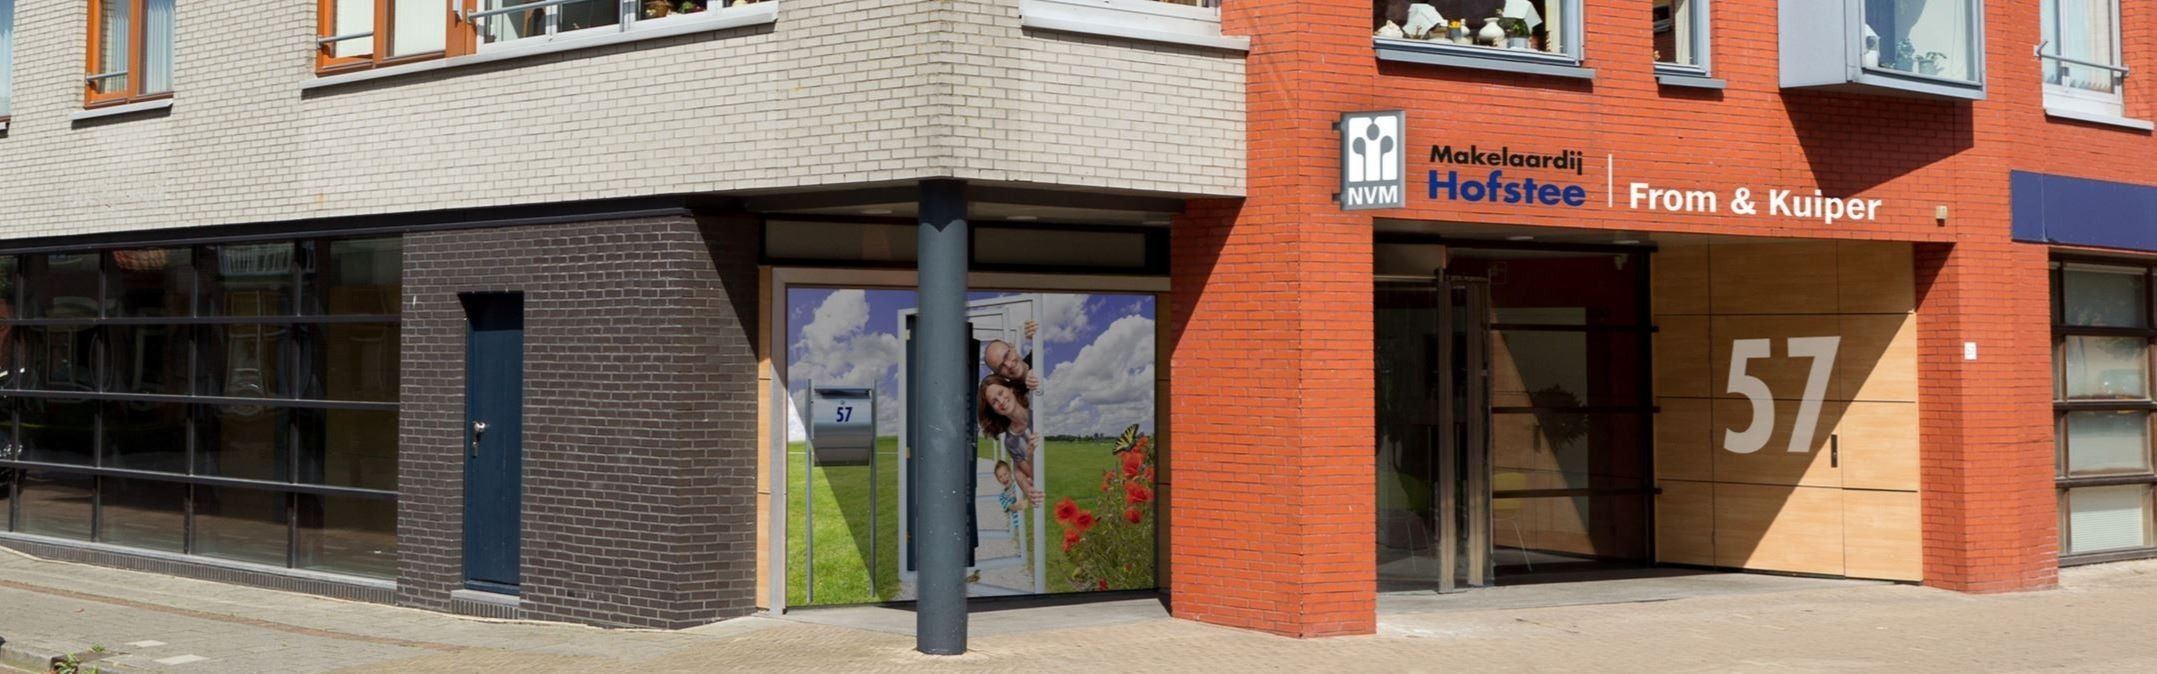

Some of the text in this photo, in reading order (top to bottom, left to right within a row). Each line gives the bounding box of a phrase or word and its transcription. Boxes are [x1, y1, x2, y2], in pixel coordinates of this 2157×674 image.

[1430, 145, 1583, 175] Makelaardij
[1348, 185, 1398, 205] NVM
[1429, 170, 1586, 207] Hofstee
[1629, 182, 1882, 224] From & Kuiper
[1723, 336, 1841, 454] 57
[836, 406, 853, 422] 57
